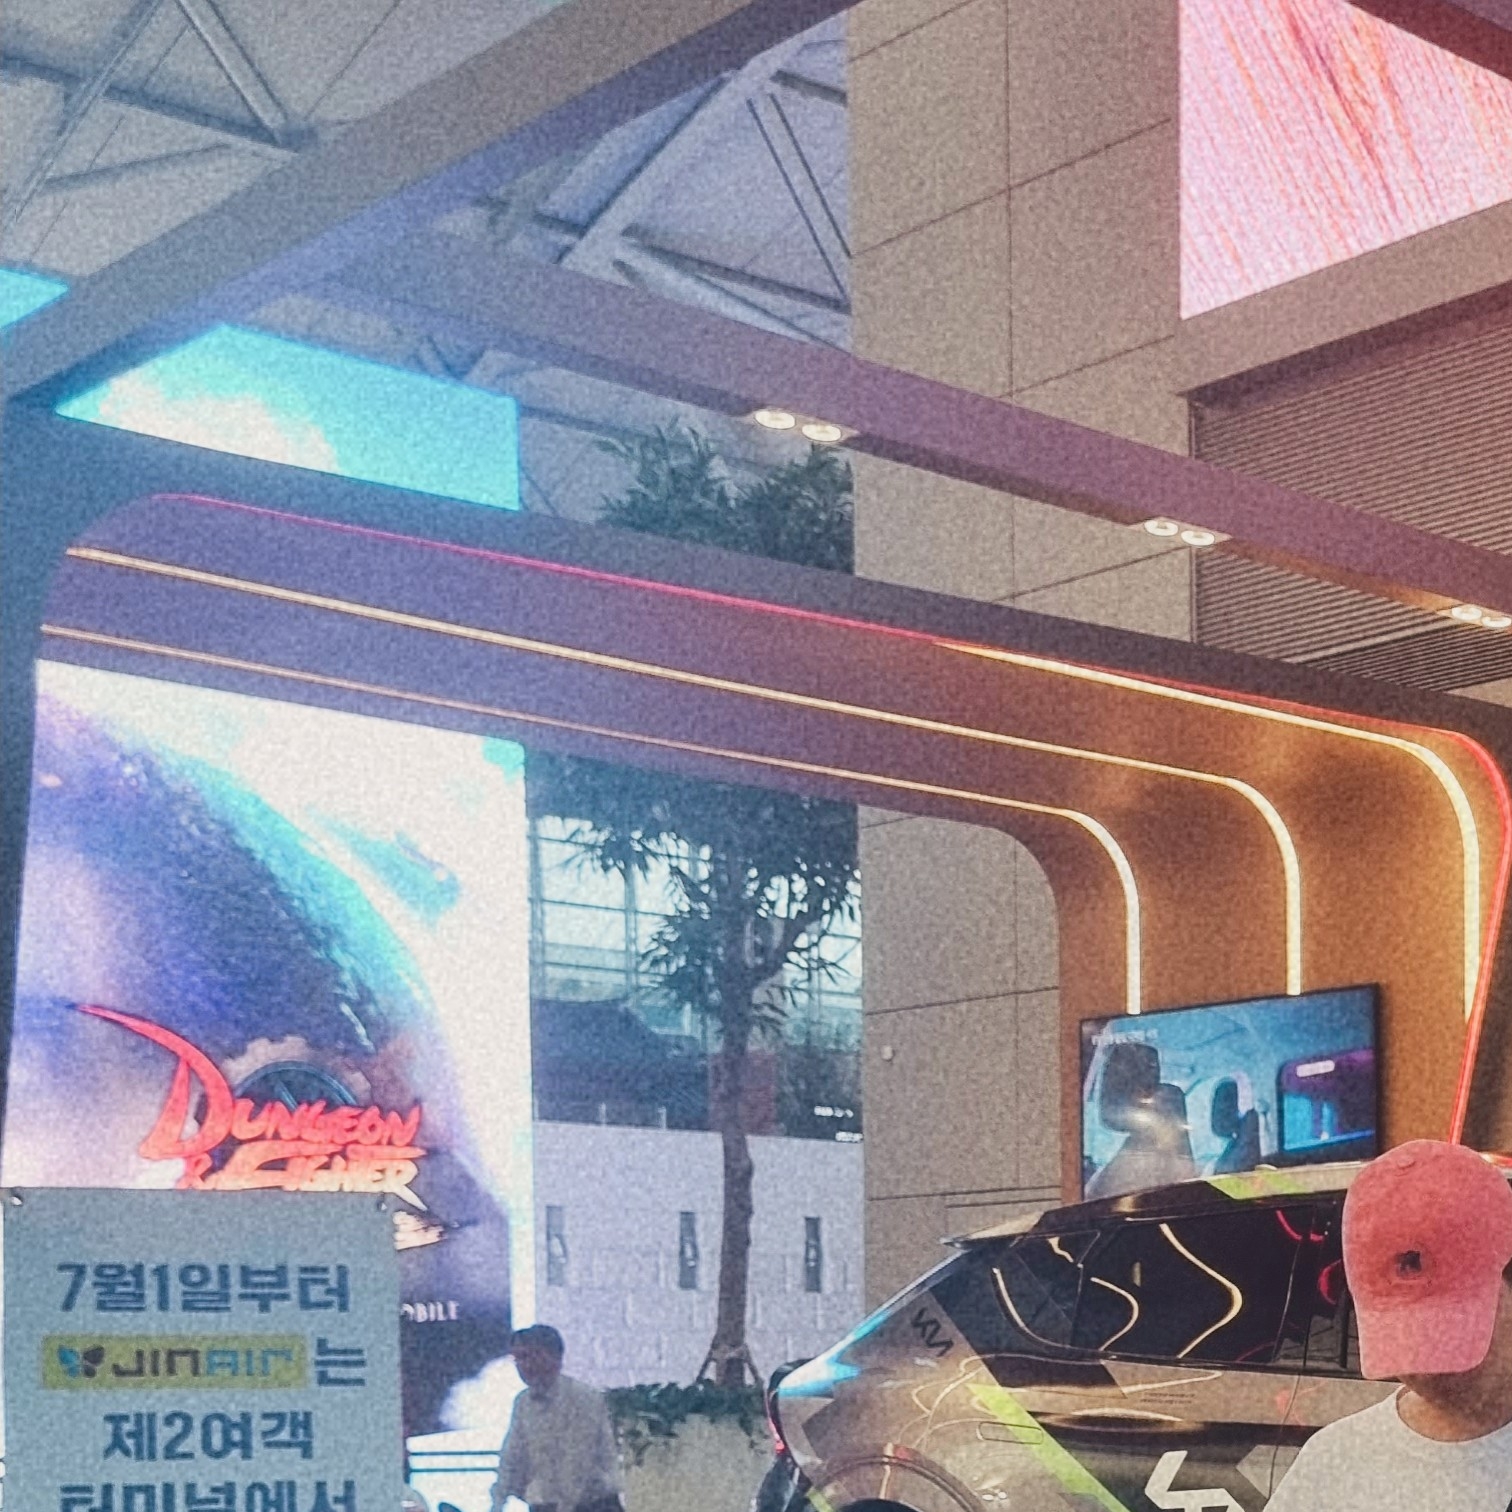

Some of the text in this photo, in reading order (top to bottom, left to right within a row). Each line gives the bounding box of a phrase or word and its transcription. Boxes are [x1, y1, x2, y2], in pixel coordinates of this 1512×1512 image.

[56, 1262, 350, 1314] 7월1일부터
[401, 1300, 459, 1323] OBILE
[314, 1337, 366, 1387] 는
[103, 1410, 315, 1461] 제2여객
